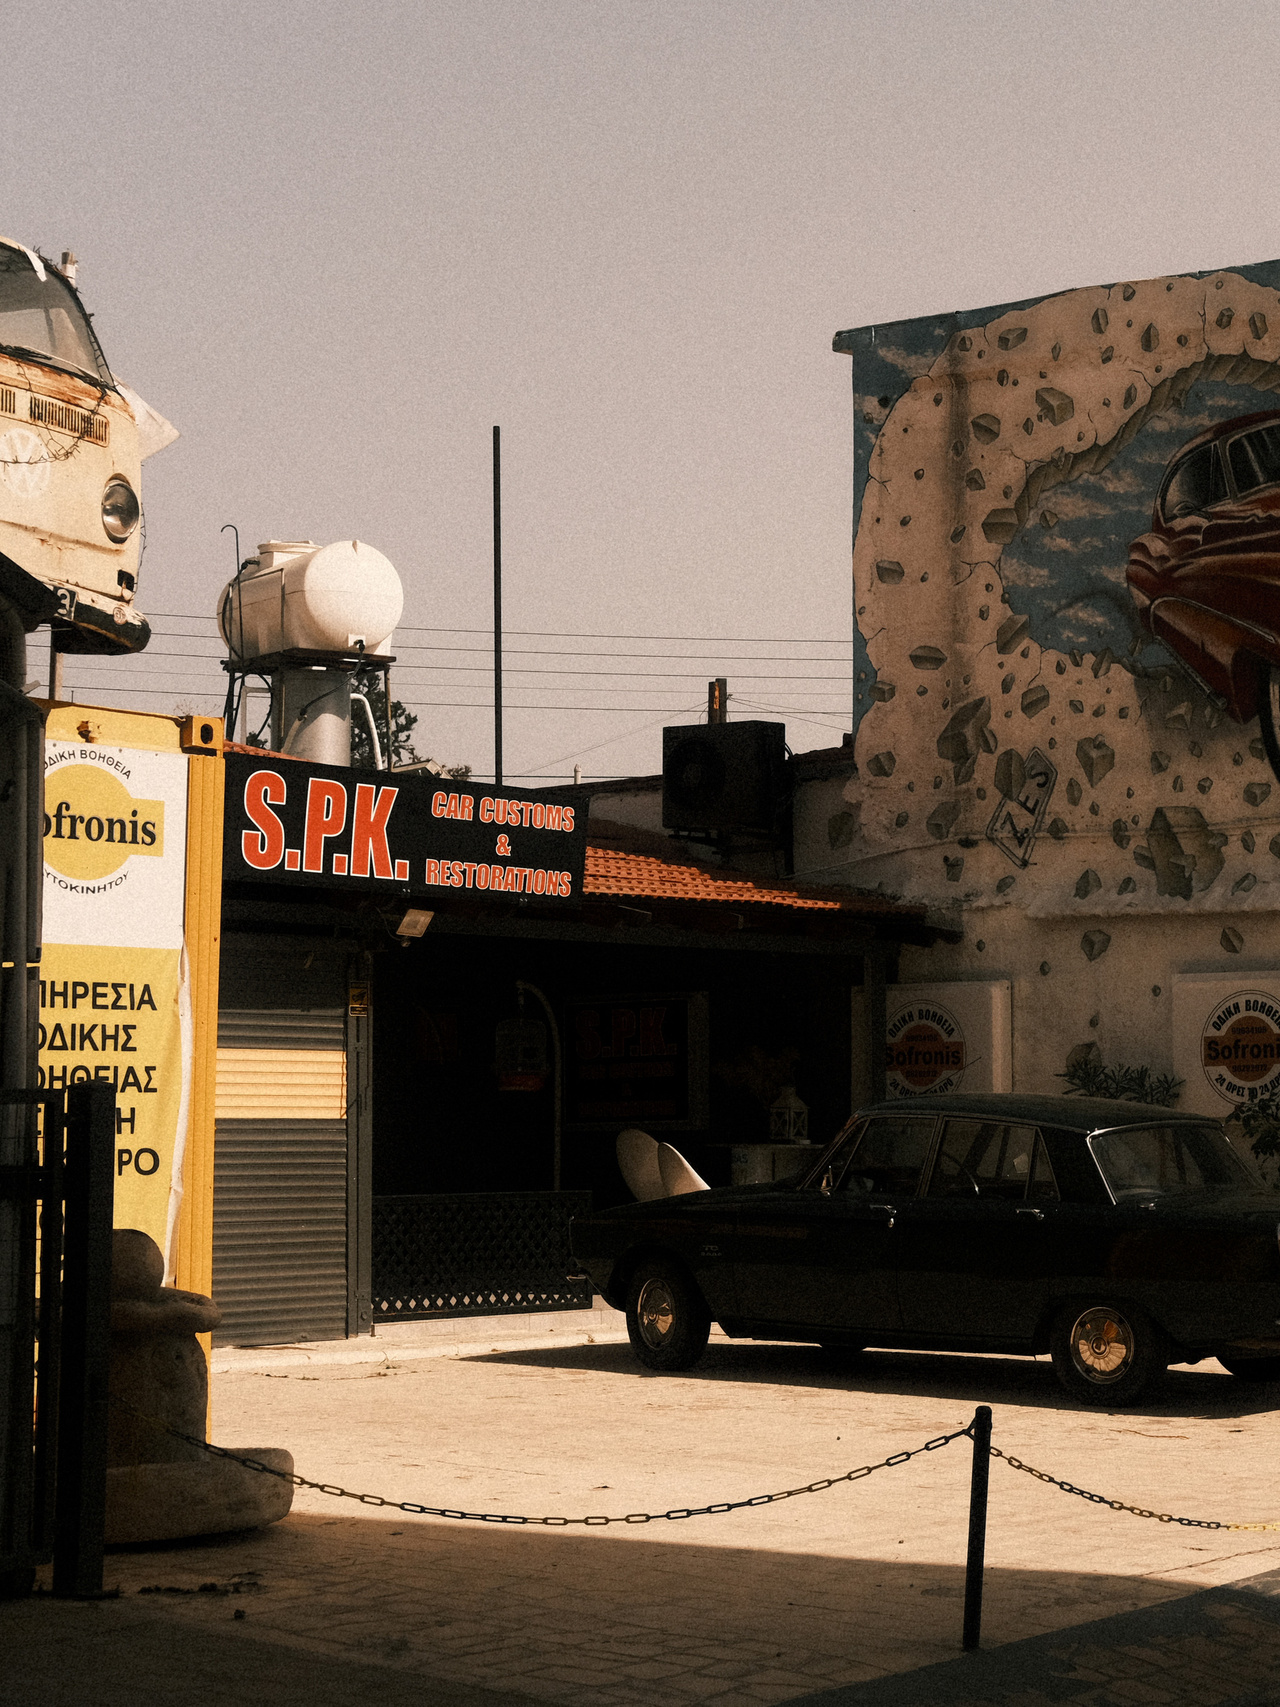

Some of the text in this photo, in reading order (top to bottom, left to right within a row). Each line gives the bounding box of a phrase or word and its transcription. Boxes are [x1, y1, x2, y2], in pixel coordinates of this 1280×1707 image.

[80, 749, 132, 780] ΒΟΗΘΕΙΑ
[241, 769, 410, 881] S.P.K.
[431, 791, 576, 833] CAR CUSTOMS
[495, 833, 512, 857] &
[43, 869, 129, 895] ΥΤΟΚΙΝΗΤΟΥ
[425, 858, 572, 897] RESTORATIONS
[888, 1008, 955, 1038] ΟΔΙΚΗ ΒΟΗΘΕΙΑ
[1212, 1002, 1241, 1031] ΟΔΙΚΗ
[1215, 1073, 1226, 1087] 24
